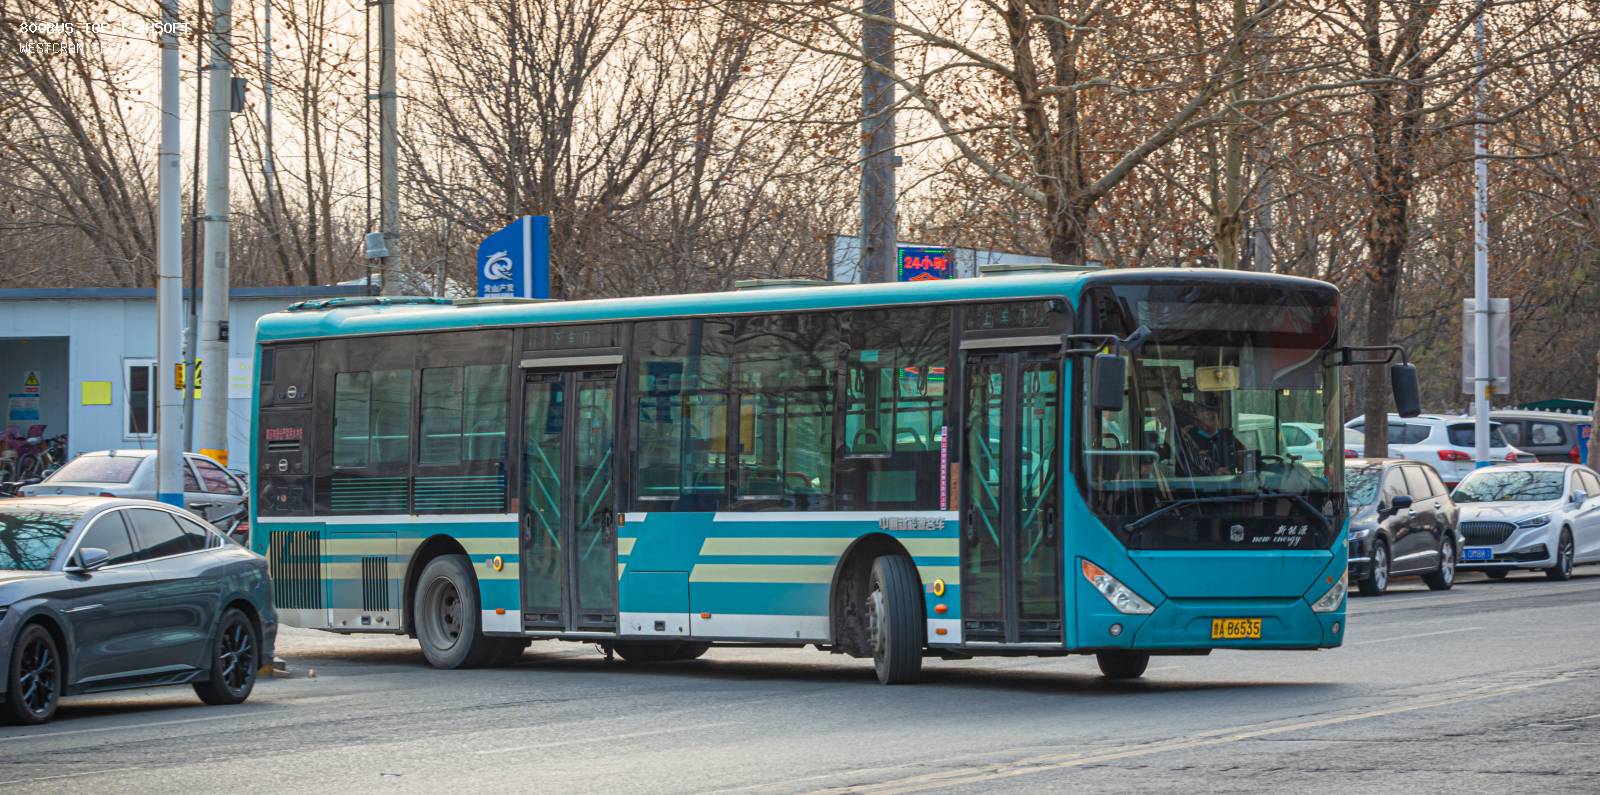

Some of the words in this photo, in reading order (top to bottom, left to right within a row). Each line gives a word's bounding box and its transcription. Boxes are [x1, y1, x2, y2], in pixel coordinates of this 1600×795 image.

[904, 255, 948, 271] 24小时
[1251, 536, 1271, 544] new
[1272, 535, 1303, 547] energy
